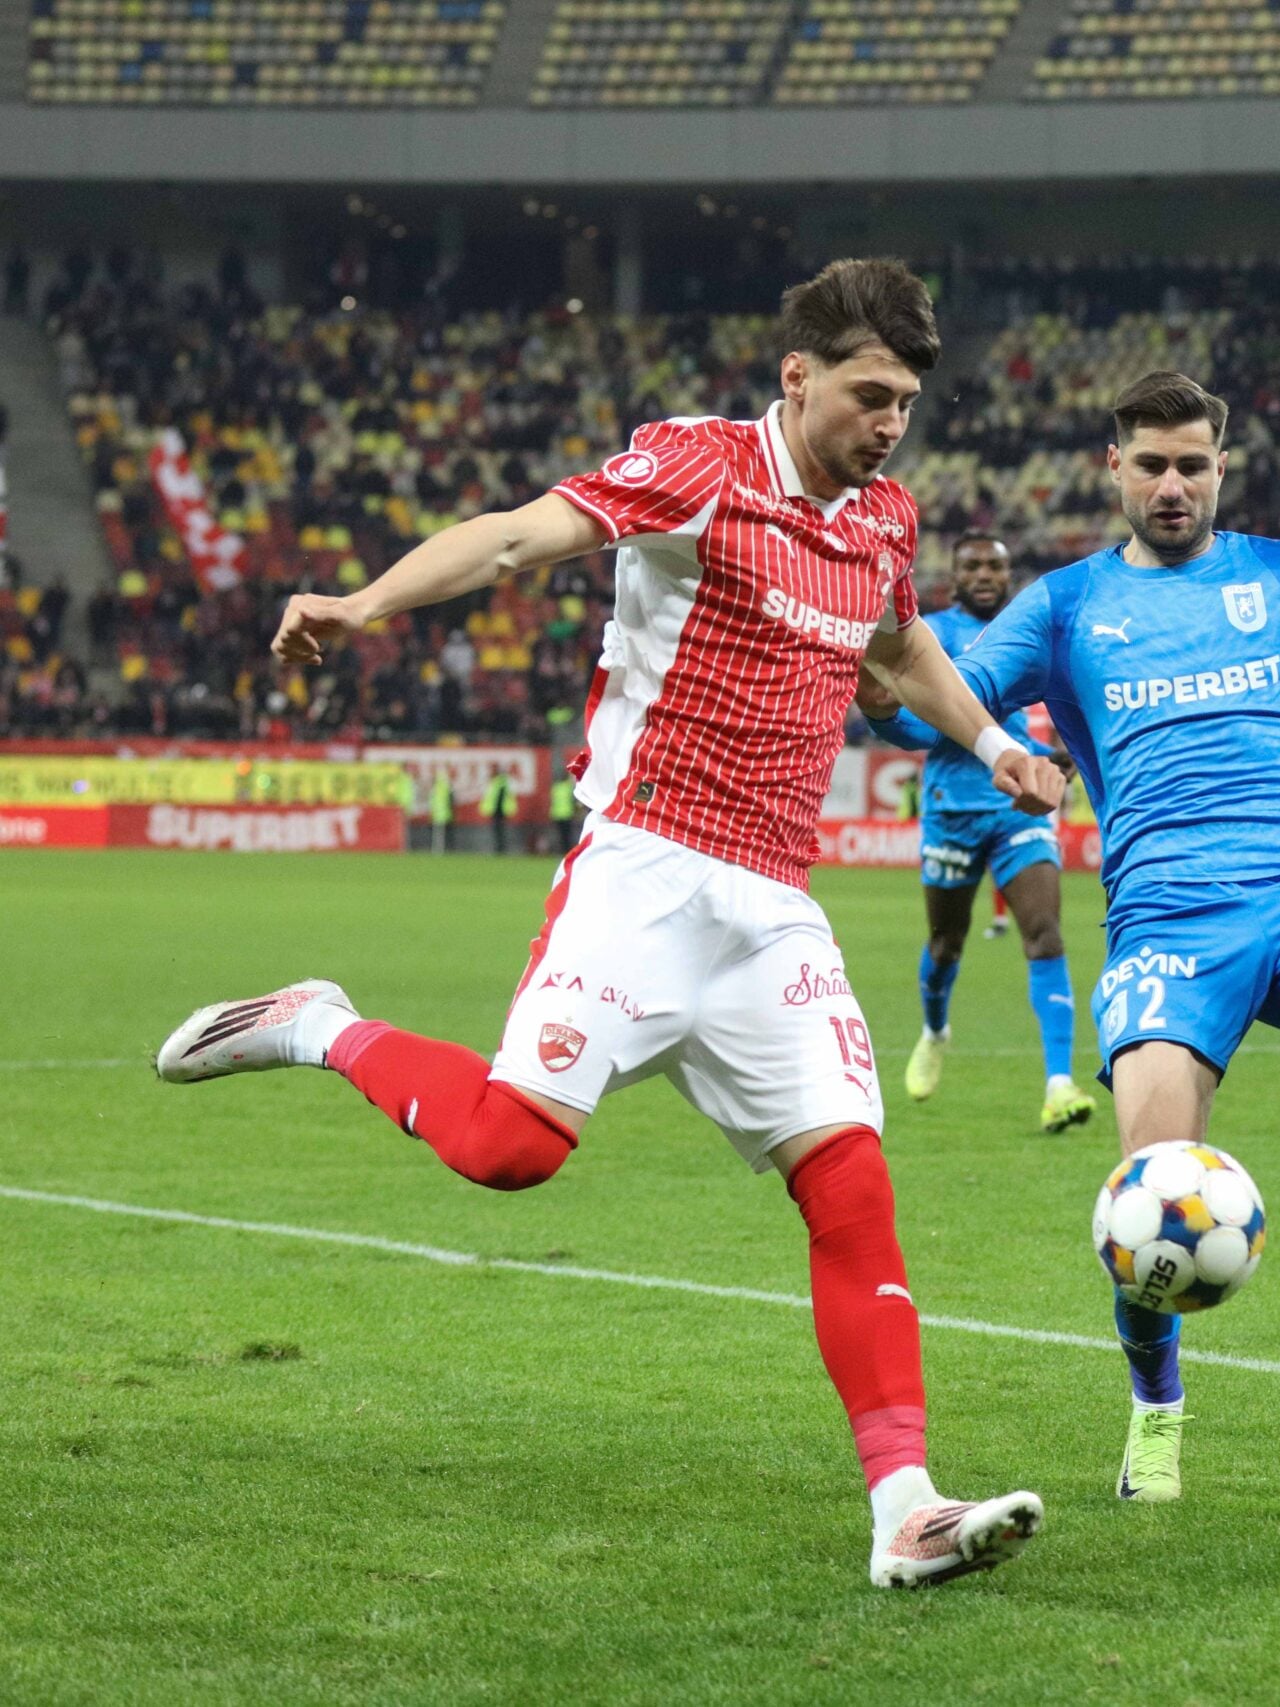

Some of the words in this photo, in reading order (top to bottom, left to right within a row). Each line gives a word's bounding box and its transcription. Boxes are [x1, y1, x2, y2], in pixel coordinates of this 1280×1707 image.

[762, 588, 879, 650] SUPERBE
[1104, 654, 1280, 711] SUPERBET
[147, 804, 363, 852] SUPERBET
[1101, 946, 1197, 998] DEVIN
[1136, 976, 1168, 1032] 2
[829, 1016, 873, 1072] 19
